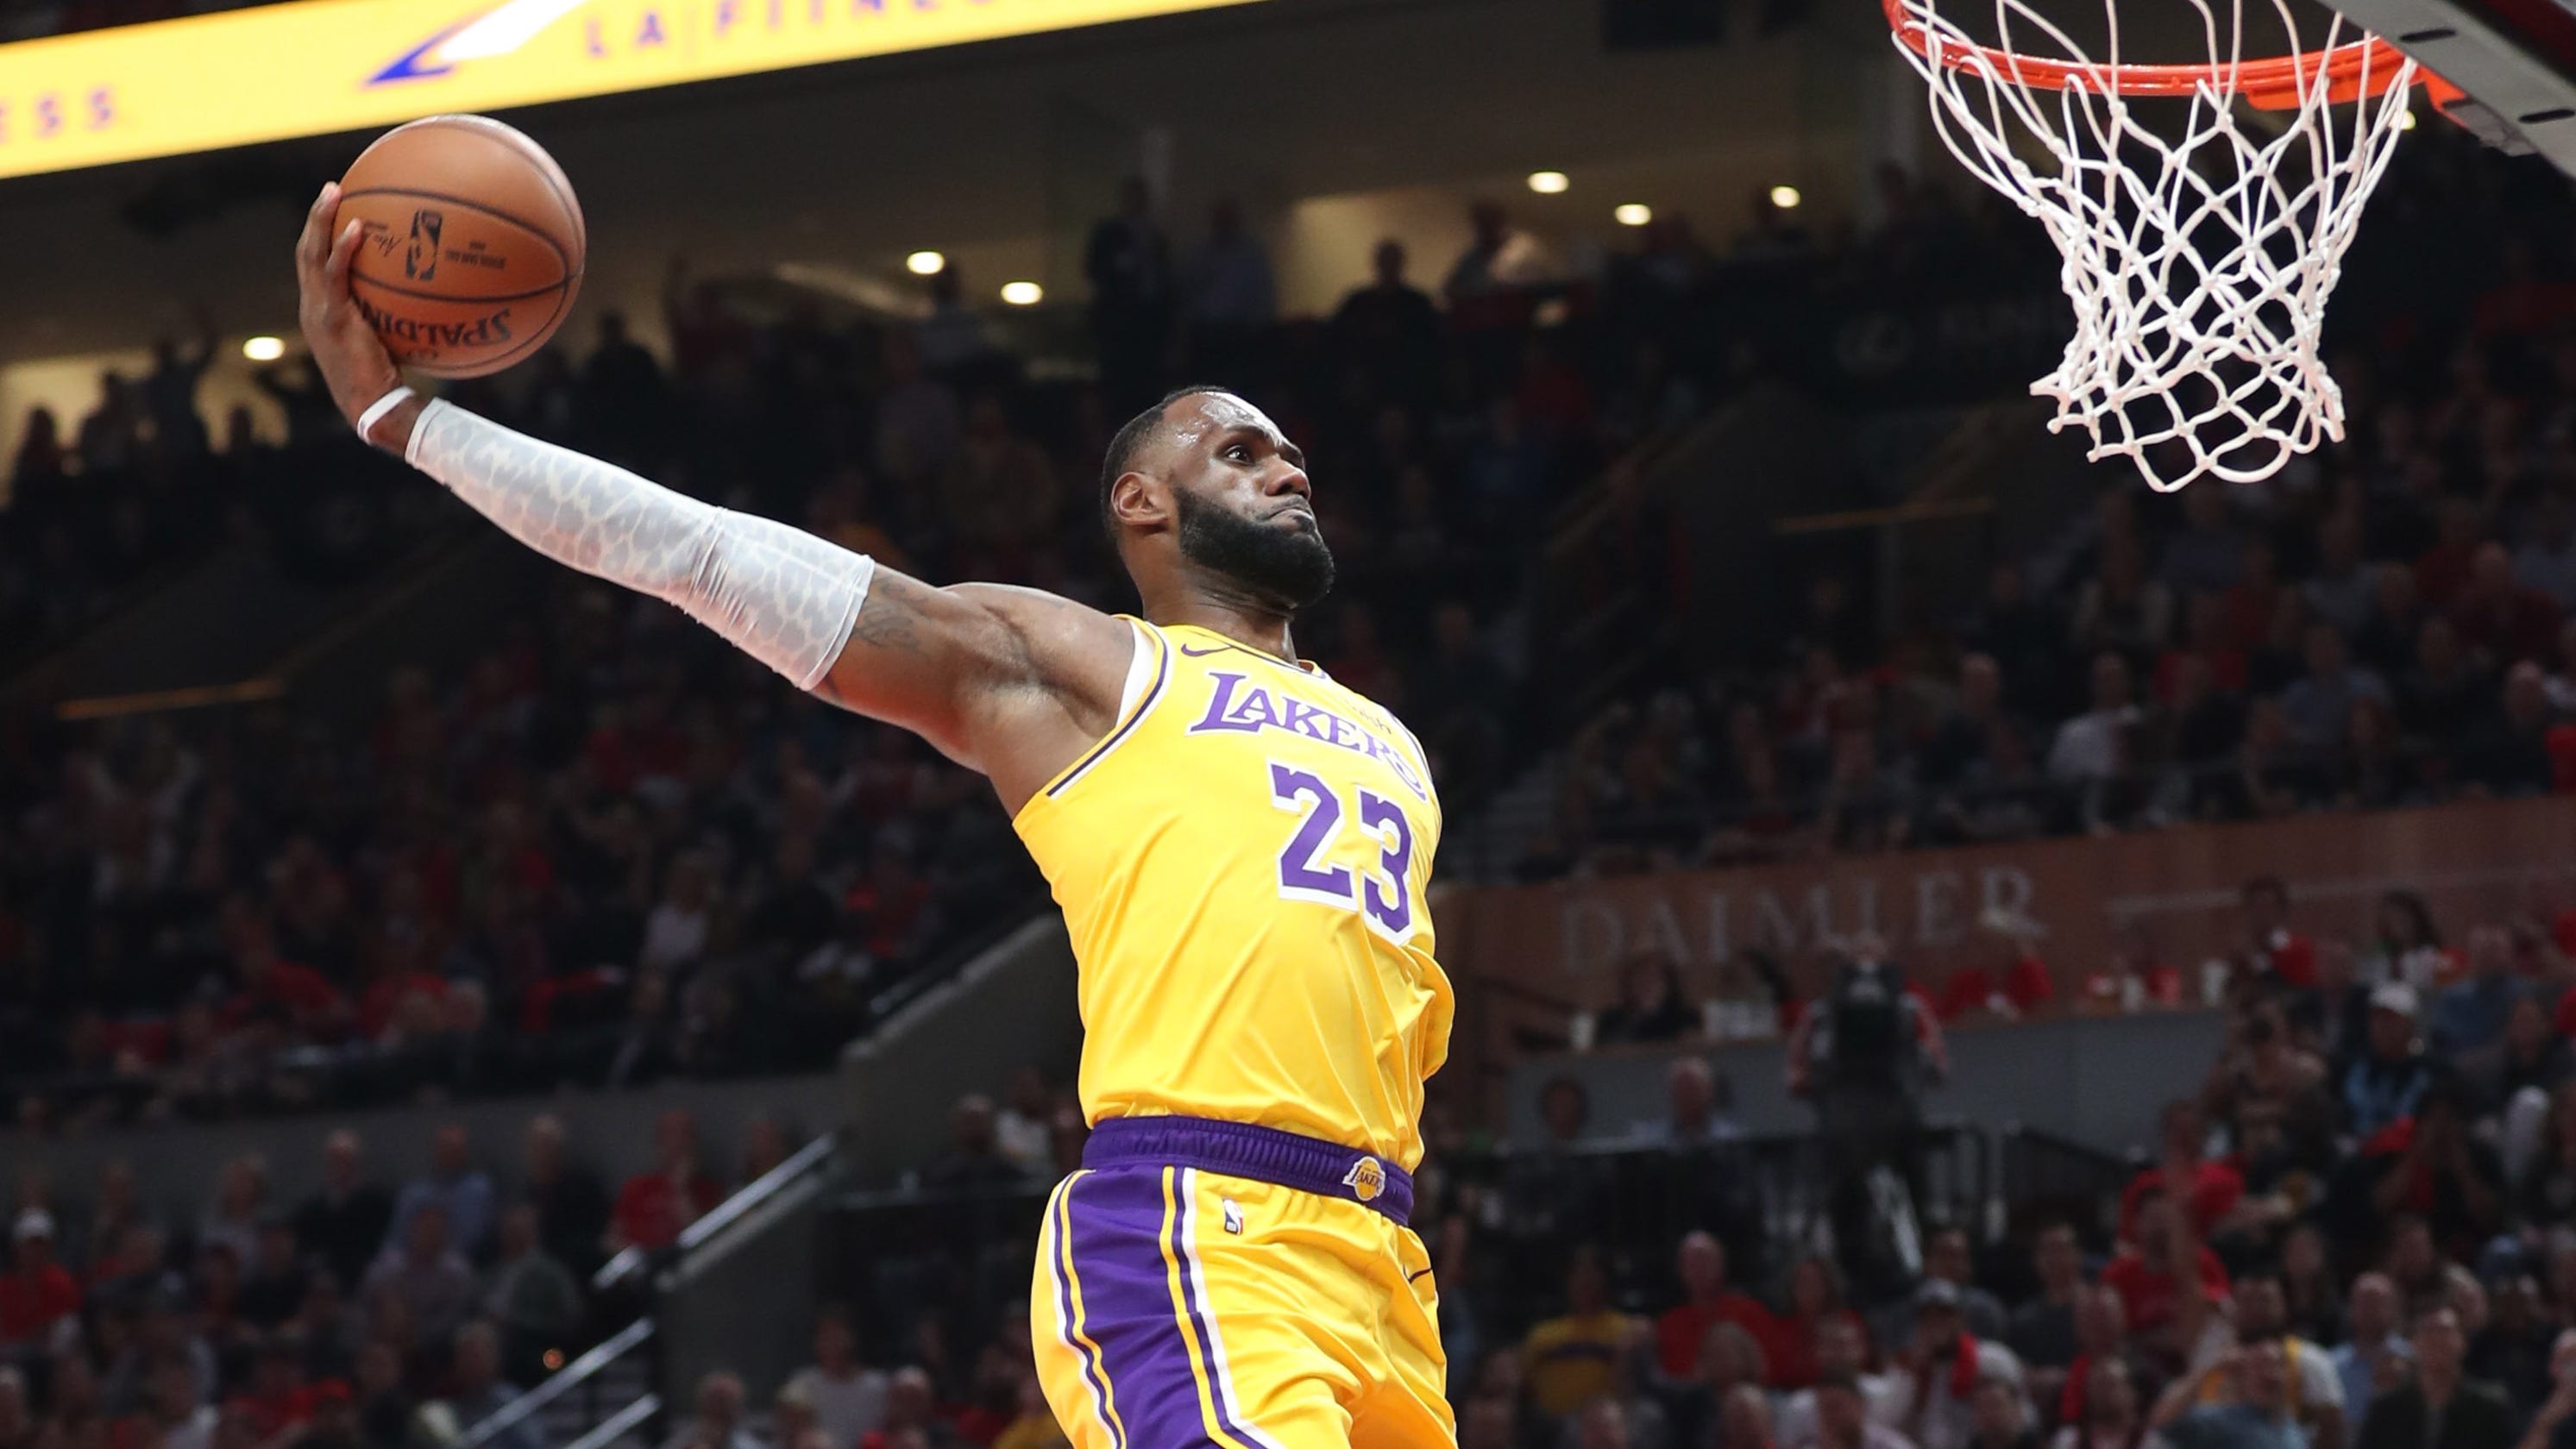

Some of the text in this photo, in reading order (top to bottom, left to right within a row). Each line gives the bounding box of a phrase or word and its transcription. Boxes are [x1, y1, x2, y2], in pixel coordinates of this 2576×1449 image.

[362, 299, 511, 347] SPALDIN
[1188, 669, 1428, 802] LAKERS
[1270, 761, 1415, 940] 23
[1561, 865, 2045, 973] DAIMLER
